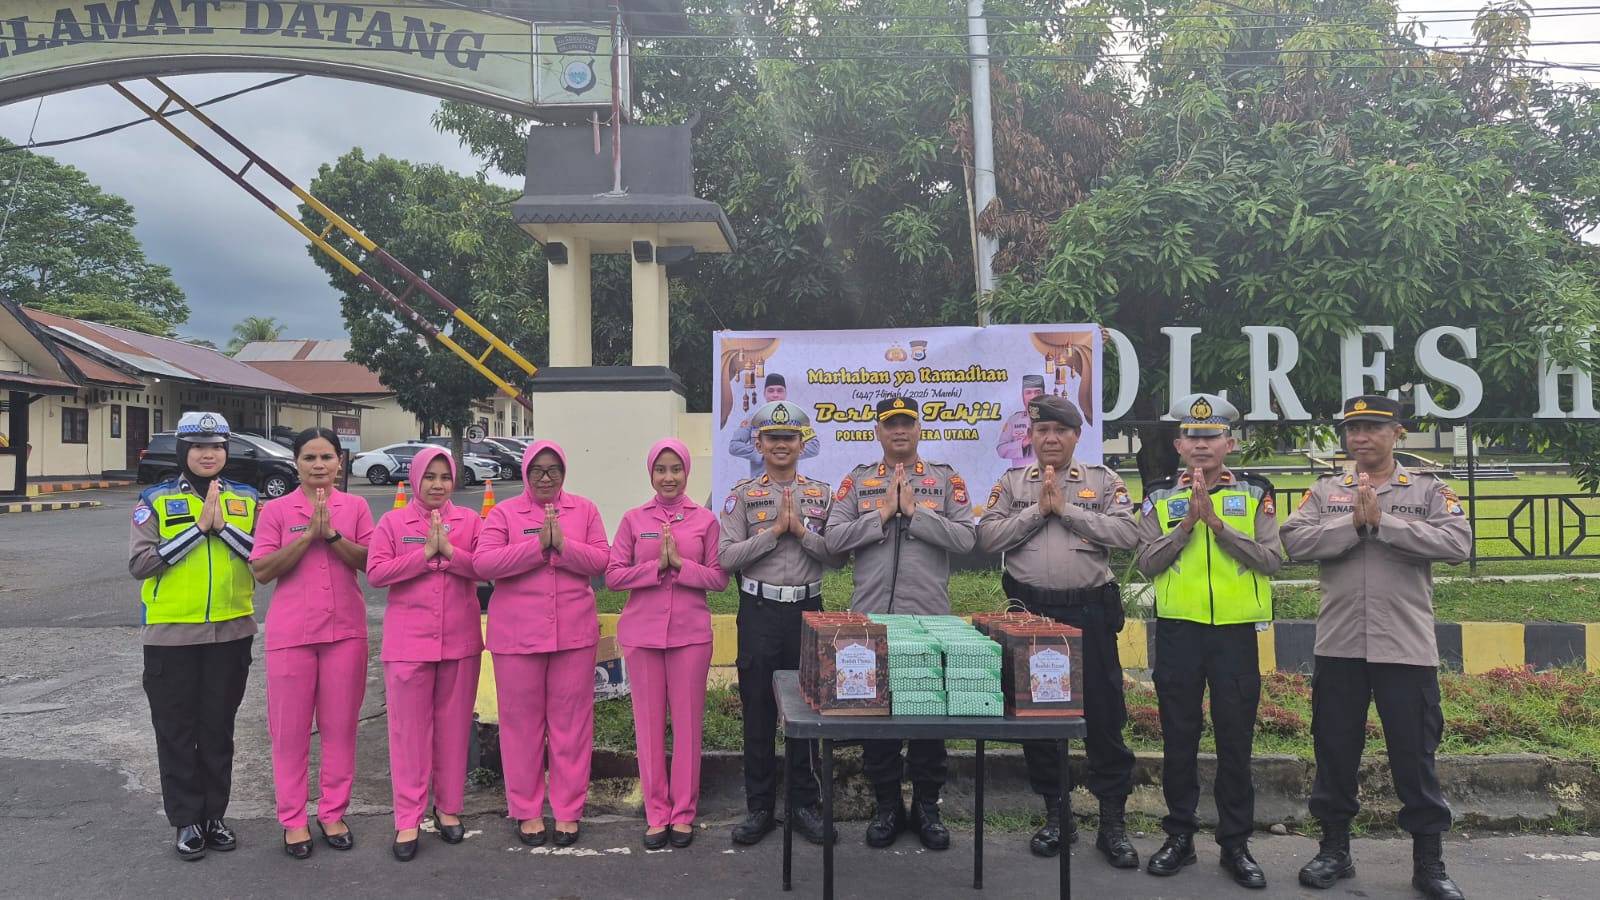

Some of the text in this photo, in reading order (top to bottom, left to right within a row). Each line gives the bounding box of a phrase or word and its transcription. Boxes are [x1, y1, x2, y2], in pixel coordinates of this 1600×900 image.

[240, 0, 486, 71] DATANG
[807, 364, 1009, 388] Marhaban ya Ramadhan
[1102, 325, 1484, 422] OLRES
[922, 401, 1002, 425] Takjil
[469, 431, 477, 442] 5
[836, 430, 875, 442] POLRES
[944, 429, 979, 441] UTARA
[914, 487, 943, 496] POLRI
[1391, 504, 1426, 516] POLRI
